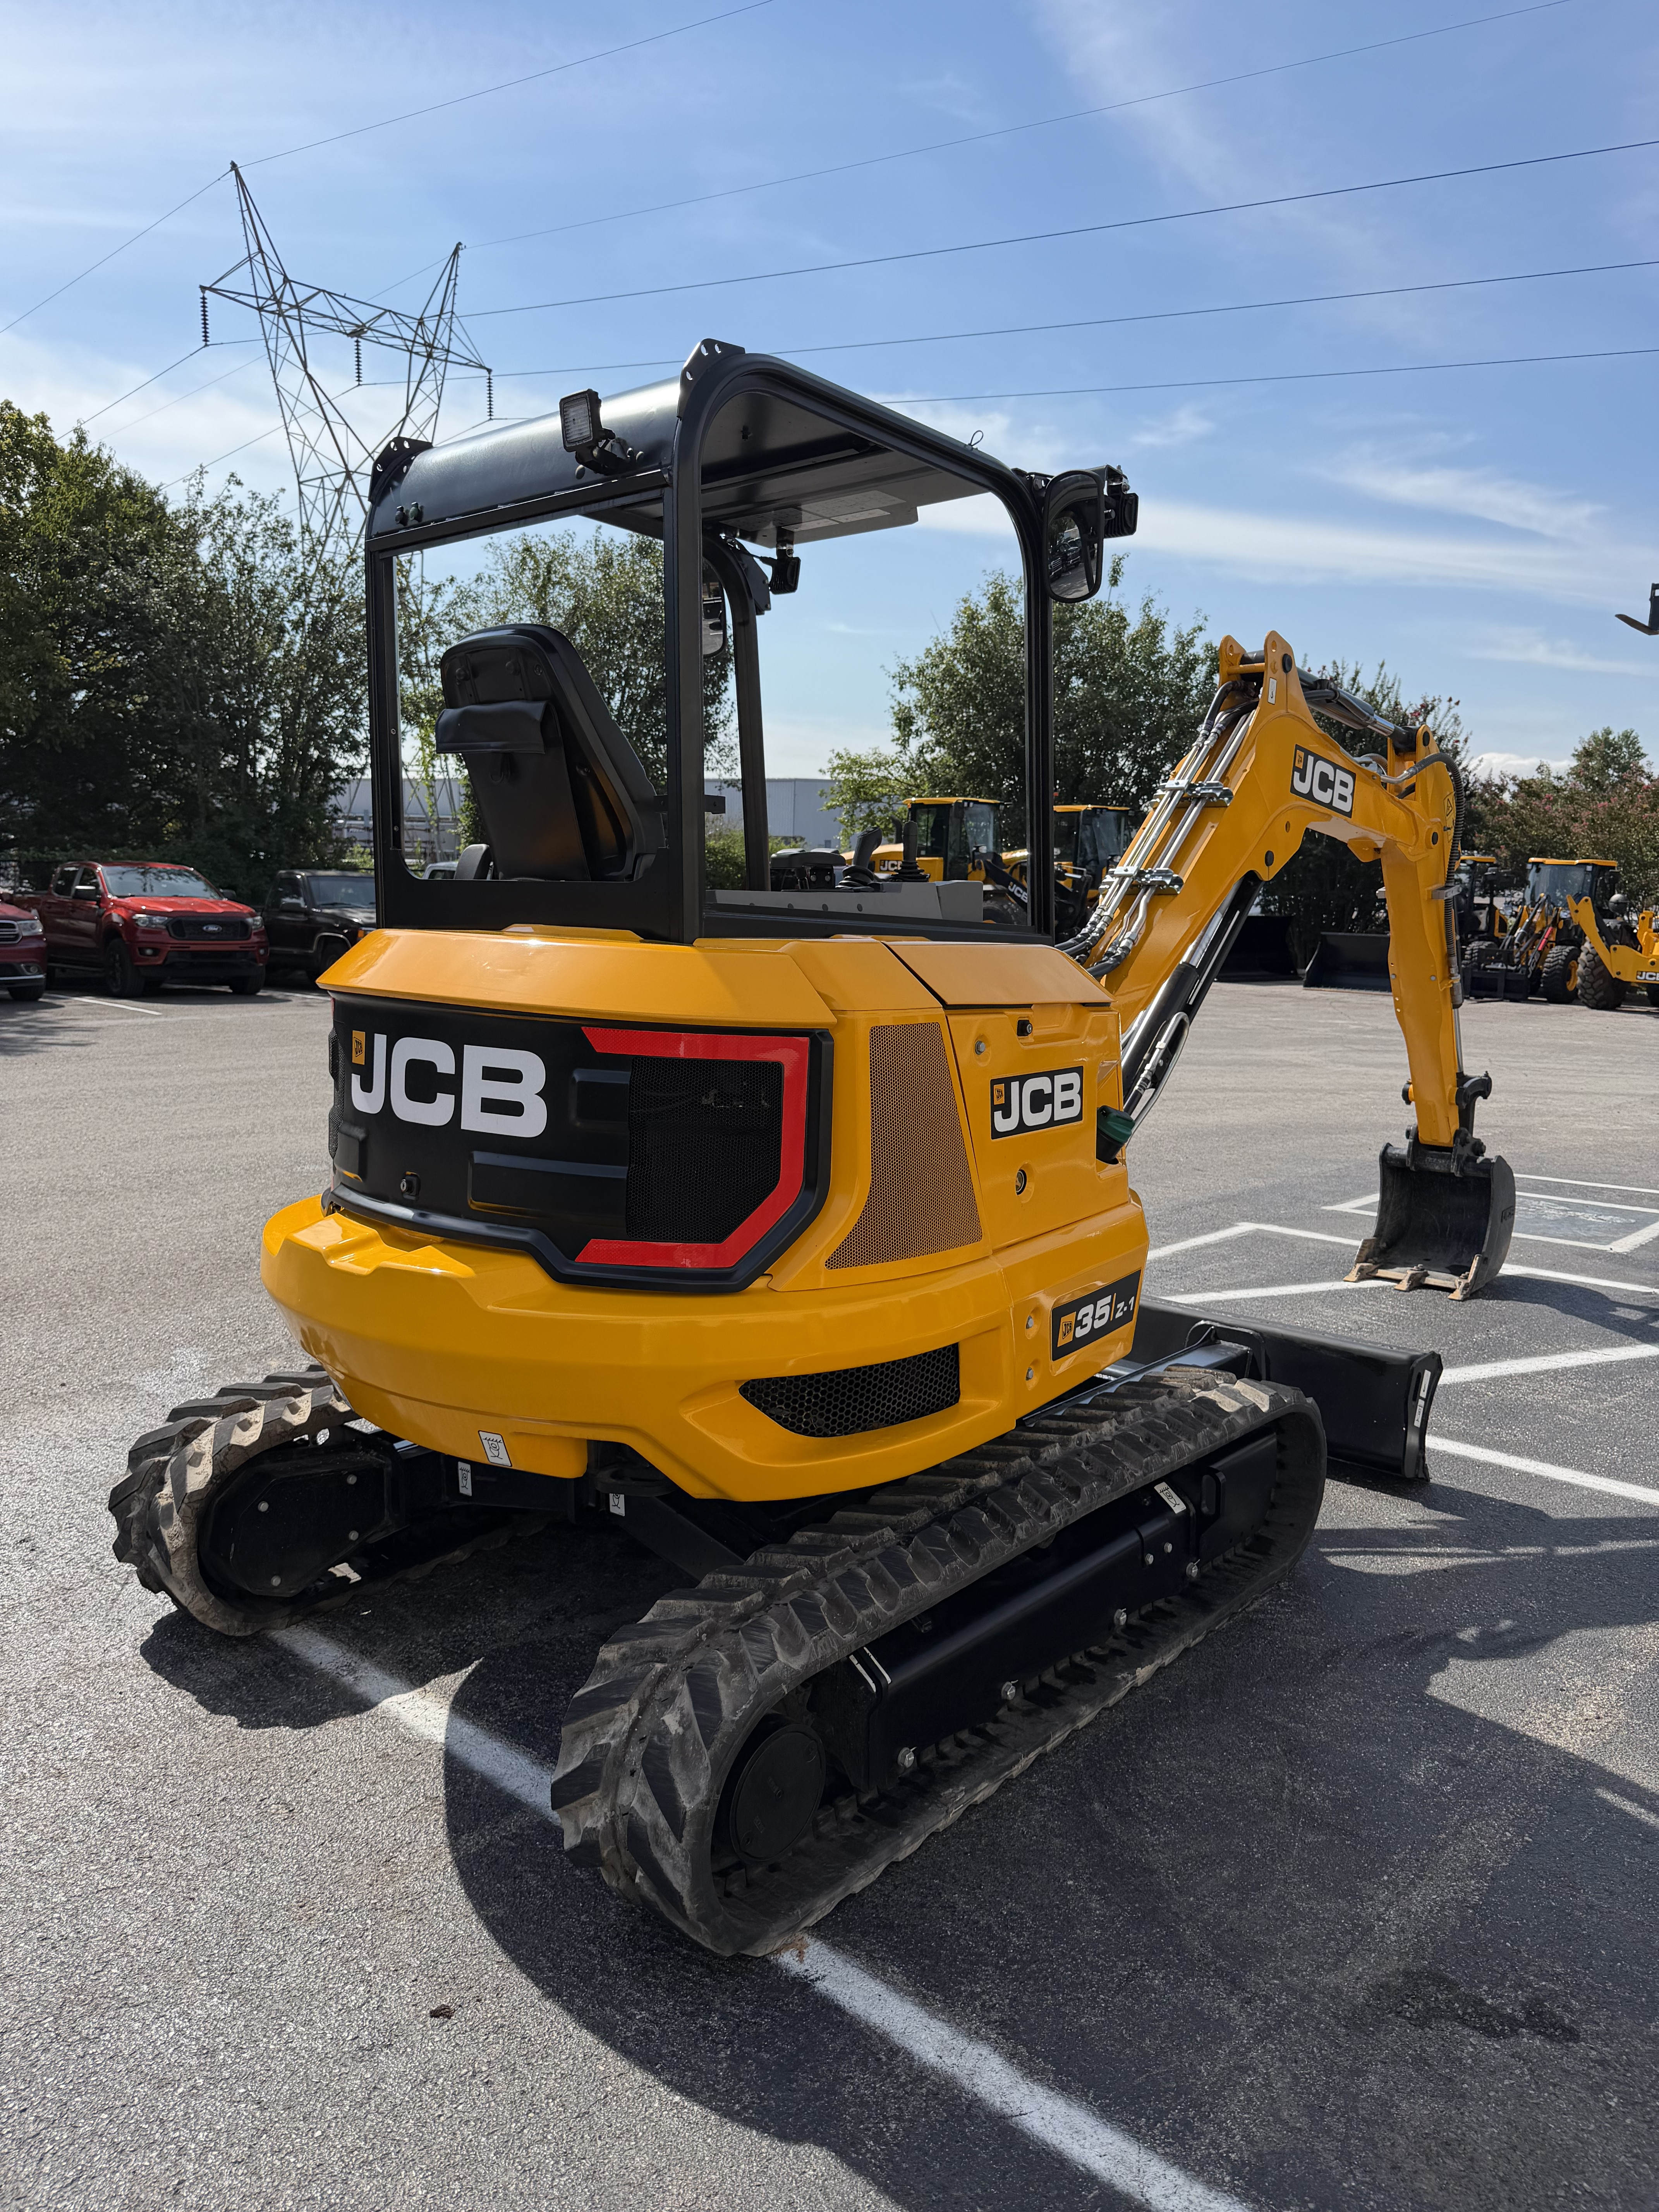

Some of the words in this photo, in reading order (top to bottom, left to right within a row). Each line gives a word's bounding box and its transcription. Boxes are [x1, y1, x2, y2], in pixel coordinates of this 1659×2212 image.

[1293, 755, 1353, 812] JCB
[1637, 972, 1659, 981] JC
[352, 1034, 547, 1137] JCB
[994, 1072, 1080, 1132] JCB
[1063, 1322, 1072, 1336] JCB
